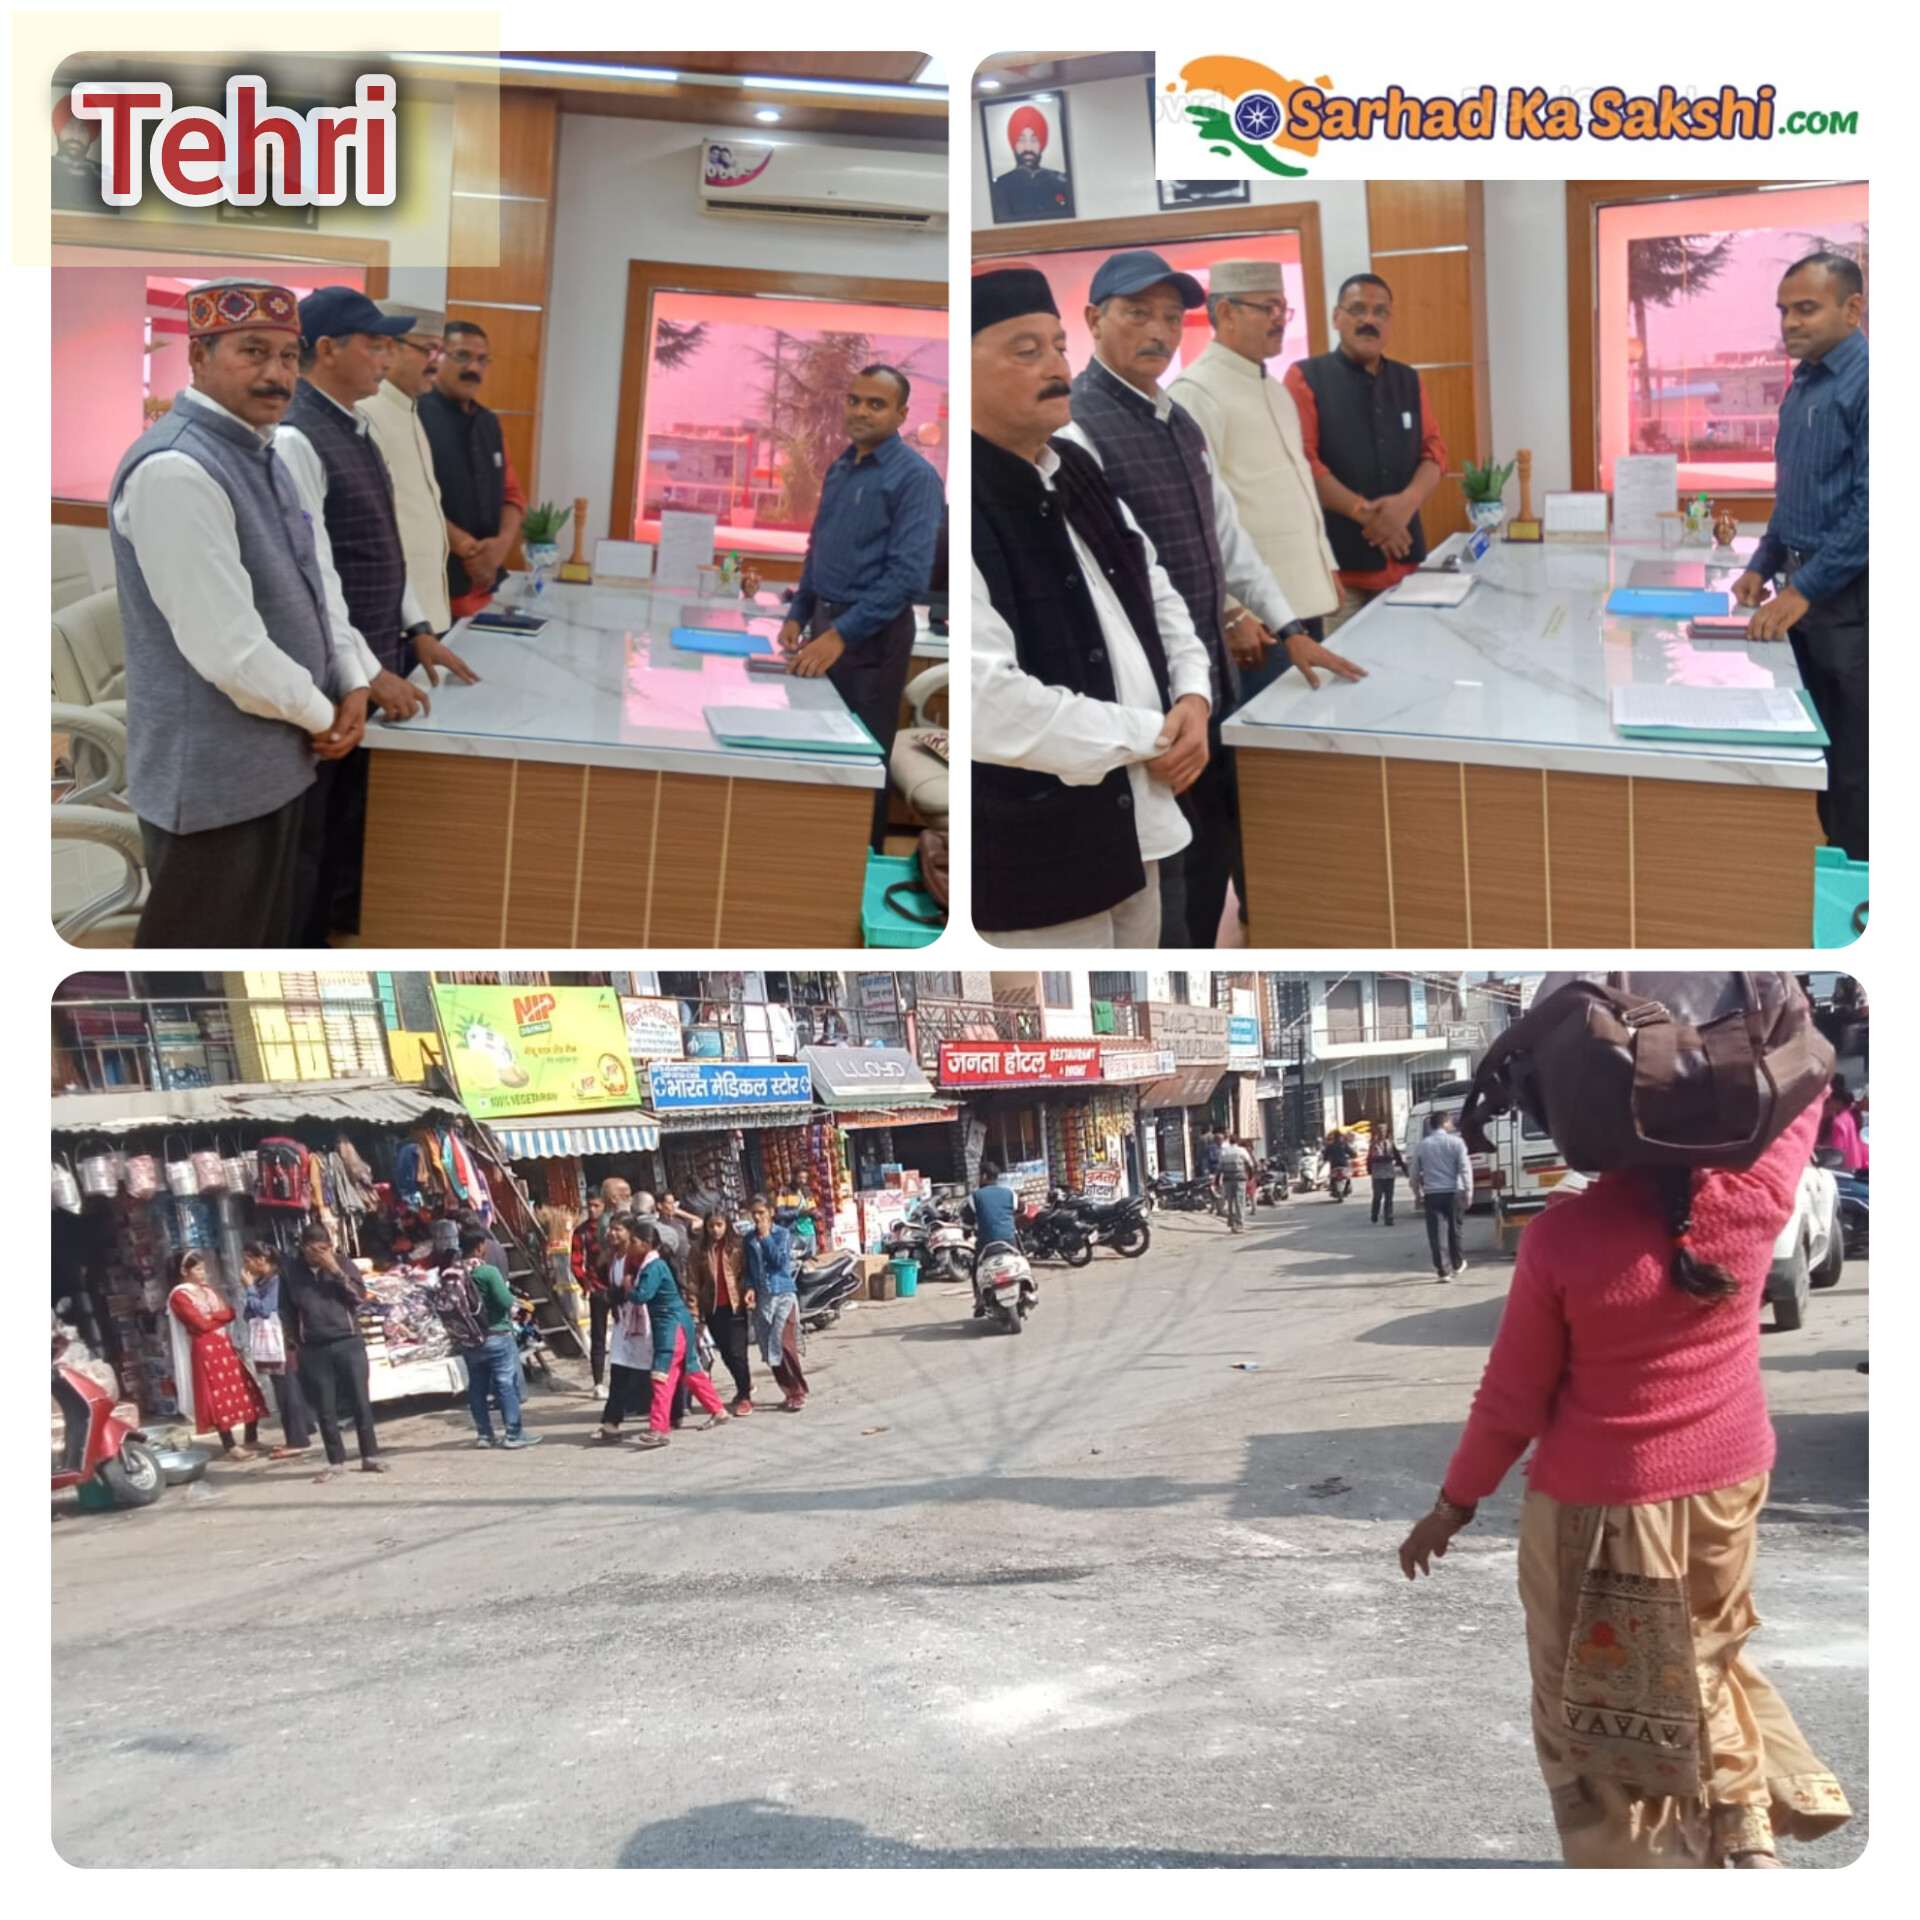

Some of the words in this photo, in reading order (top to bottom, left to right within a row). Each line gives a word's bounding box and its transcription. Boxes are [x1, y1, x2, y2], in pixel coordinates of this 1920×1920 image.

[513, 993, 556, 1024] NIP
[836, 1060, 906, 1078] LLOYD
[946, 1051, 999, 1074] जनता
[1004, 1044, 1046, 1075] होटल
[667, 1077, 707, 1098] भारत
[710, 1071, 768, 1099] मेडिकल
[770, 1071, 800, 1096] स्टोर
